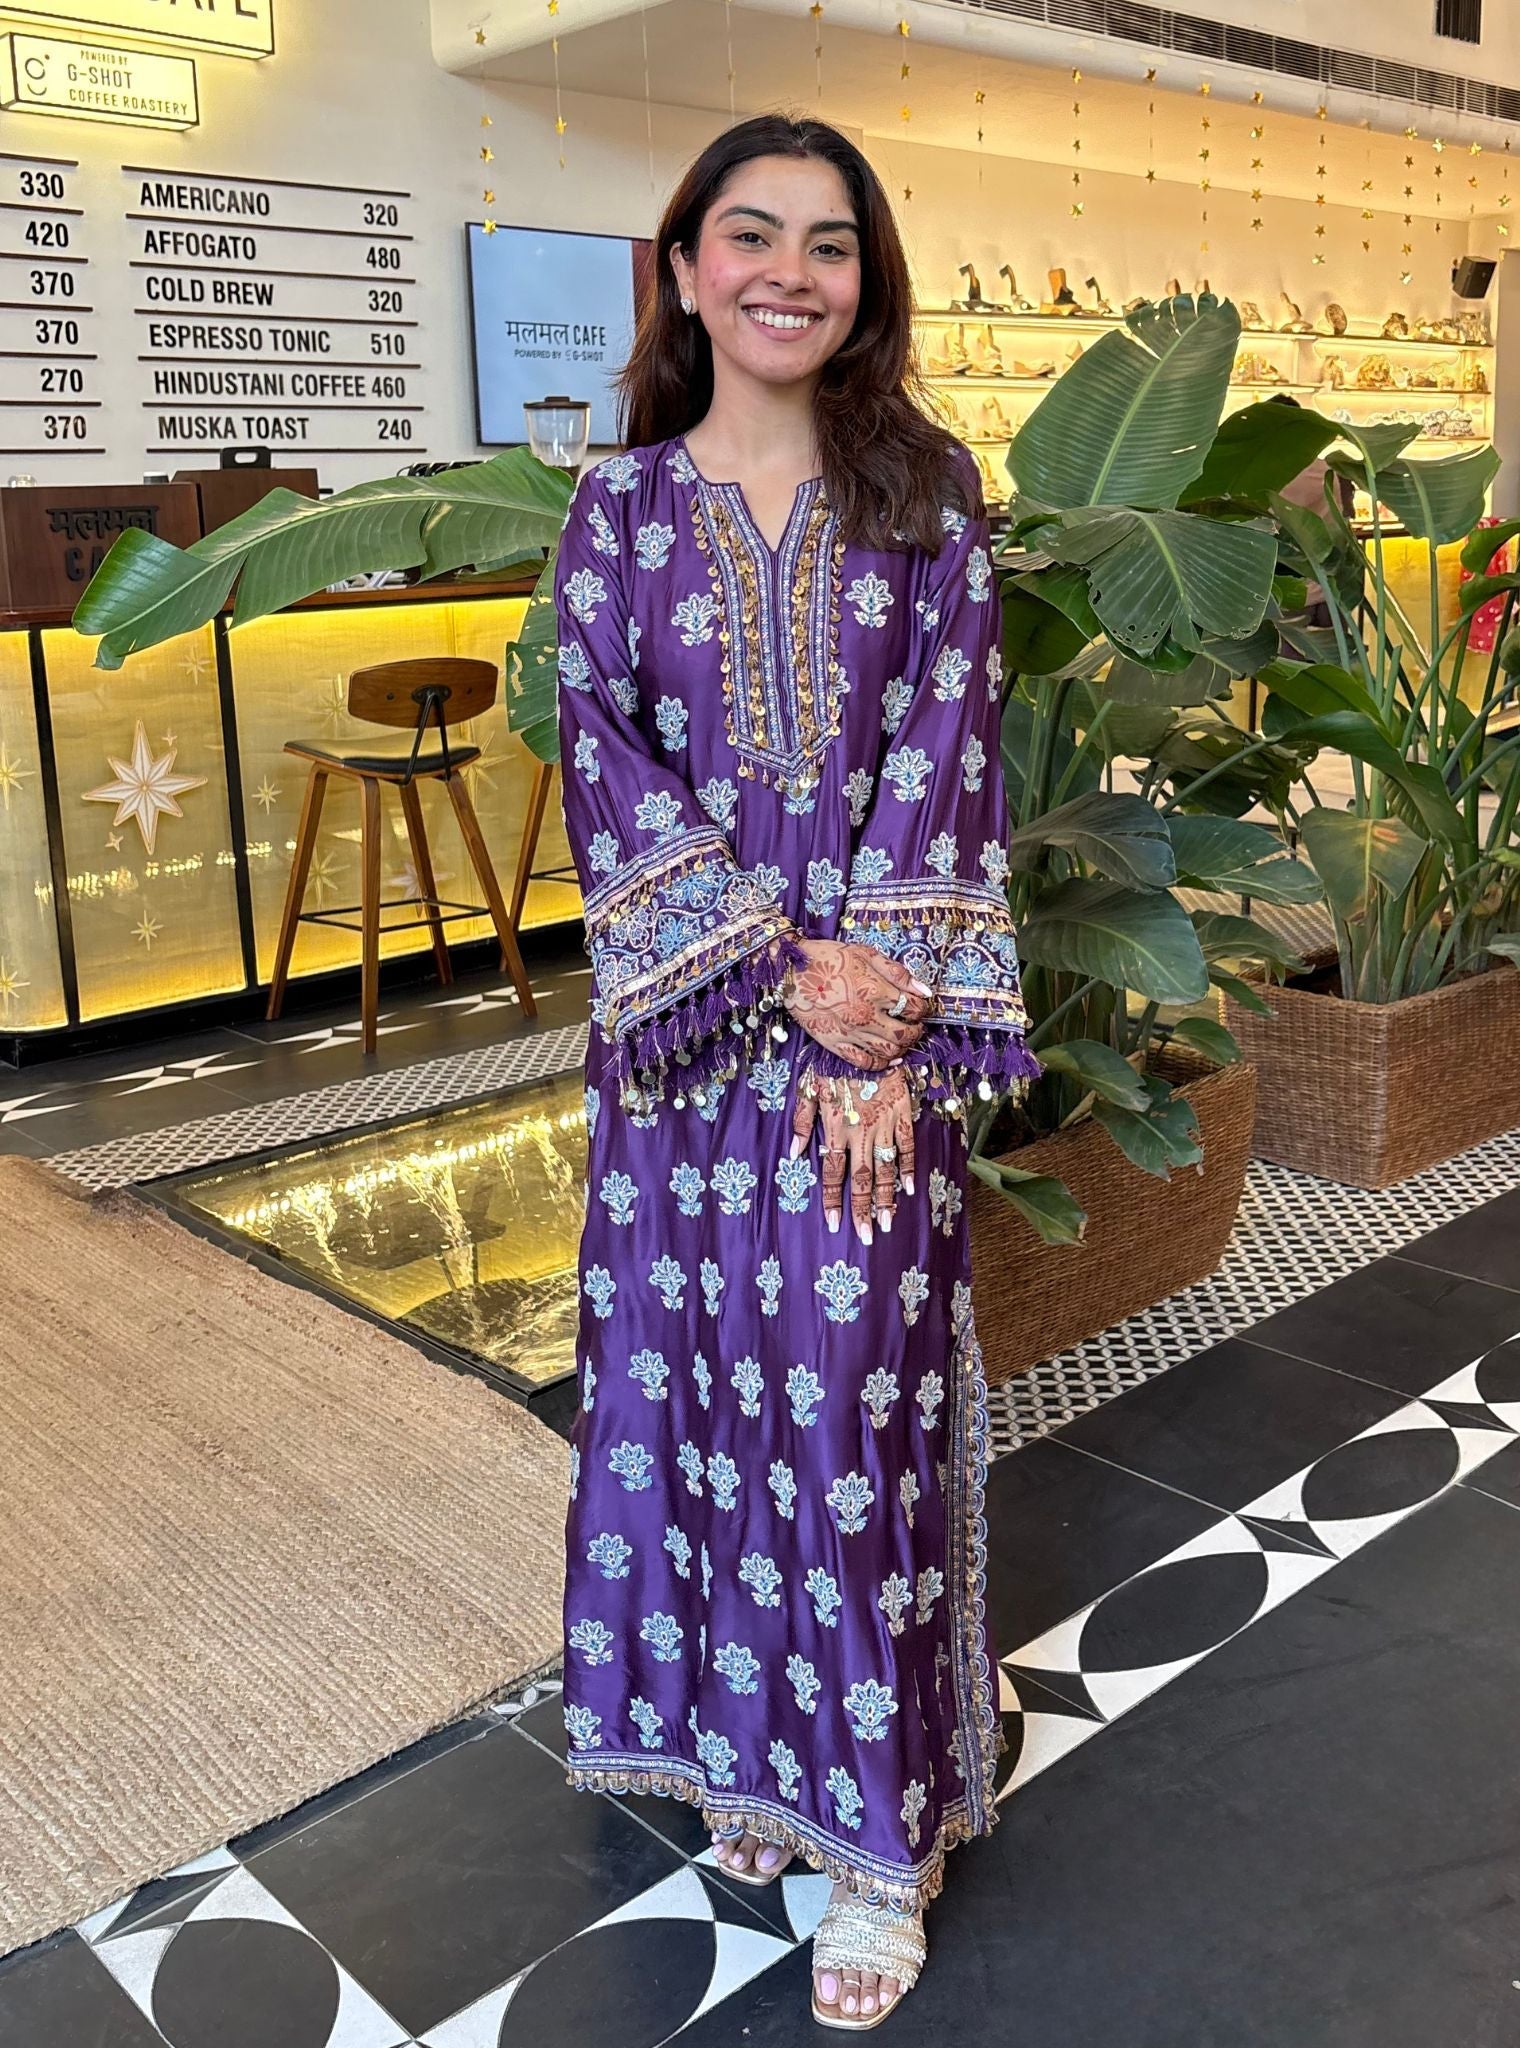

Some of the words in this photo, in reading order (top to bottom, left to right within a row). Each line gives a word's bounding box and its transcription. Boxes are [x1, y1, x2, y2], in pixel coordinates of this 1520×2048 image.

[80, 50, 116, 65] POWERED
[118, 56, 128, 66] BY
[67, 63, 133, 89] G-SHOT
[69, 88, 118, 107] COFFEE
[123, 95, 188, 115] ROASTERY
[20, 171, 65, 198] 330
[140, 182, 270, 216] AMERICANO
[363, 203, 398, 227] 320
[25, 221, 69, 248] 420
[144, 229, 256, 260] AFFOGATO
[366, 246, 400, 270] 480
[30, 270, 74, 296] 370
[146, 276, 204, 302] COLD
[212, 280, 274, 306] BREW
[368, 290, 402, 313] 320
[35, 319, 79, 345] 370
[149, 324, 262, 351] ESPRESSO
[268, 329, 331, 353] TONIC
[370, 333, 405, 356] 510
[505, 321, 570, 346] मलमल
[573, 325, 606, 347] CAFE
[514, 349, 551, 359] POWERED
[552, 350, 562, 360] BY
[573, 350, 604, 362] G-SHOT
[40, 368, 83, 393] 270
[154, 370, 284, 396] HINDUSTANI
[291, 374, 366, 397] COFFEE
[371, 376, 405, 398] 460
[44, 415, 86, 440] 370
[158, 416, 237, 440] MUSKA
[242, 416, 309, 440] TOAST
[377, 418, 411, 440] 240
